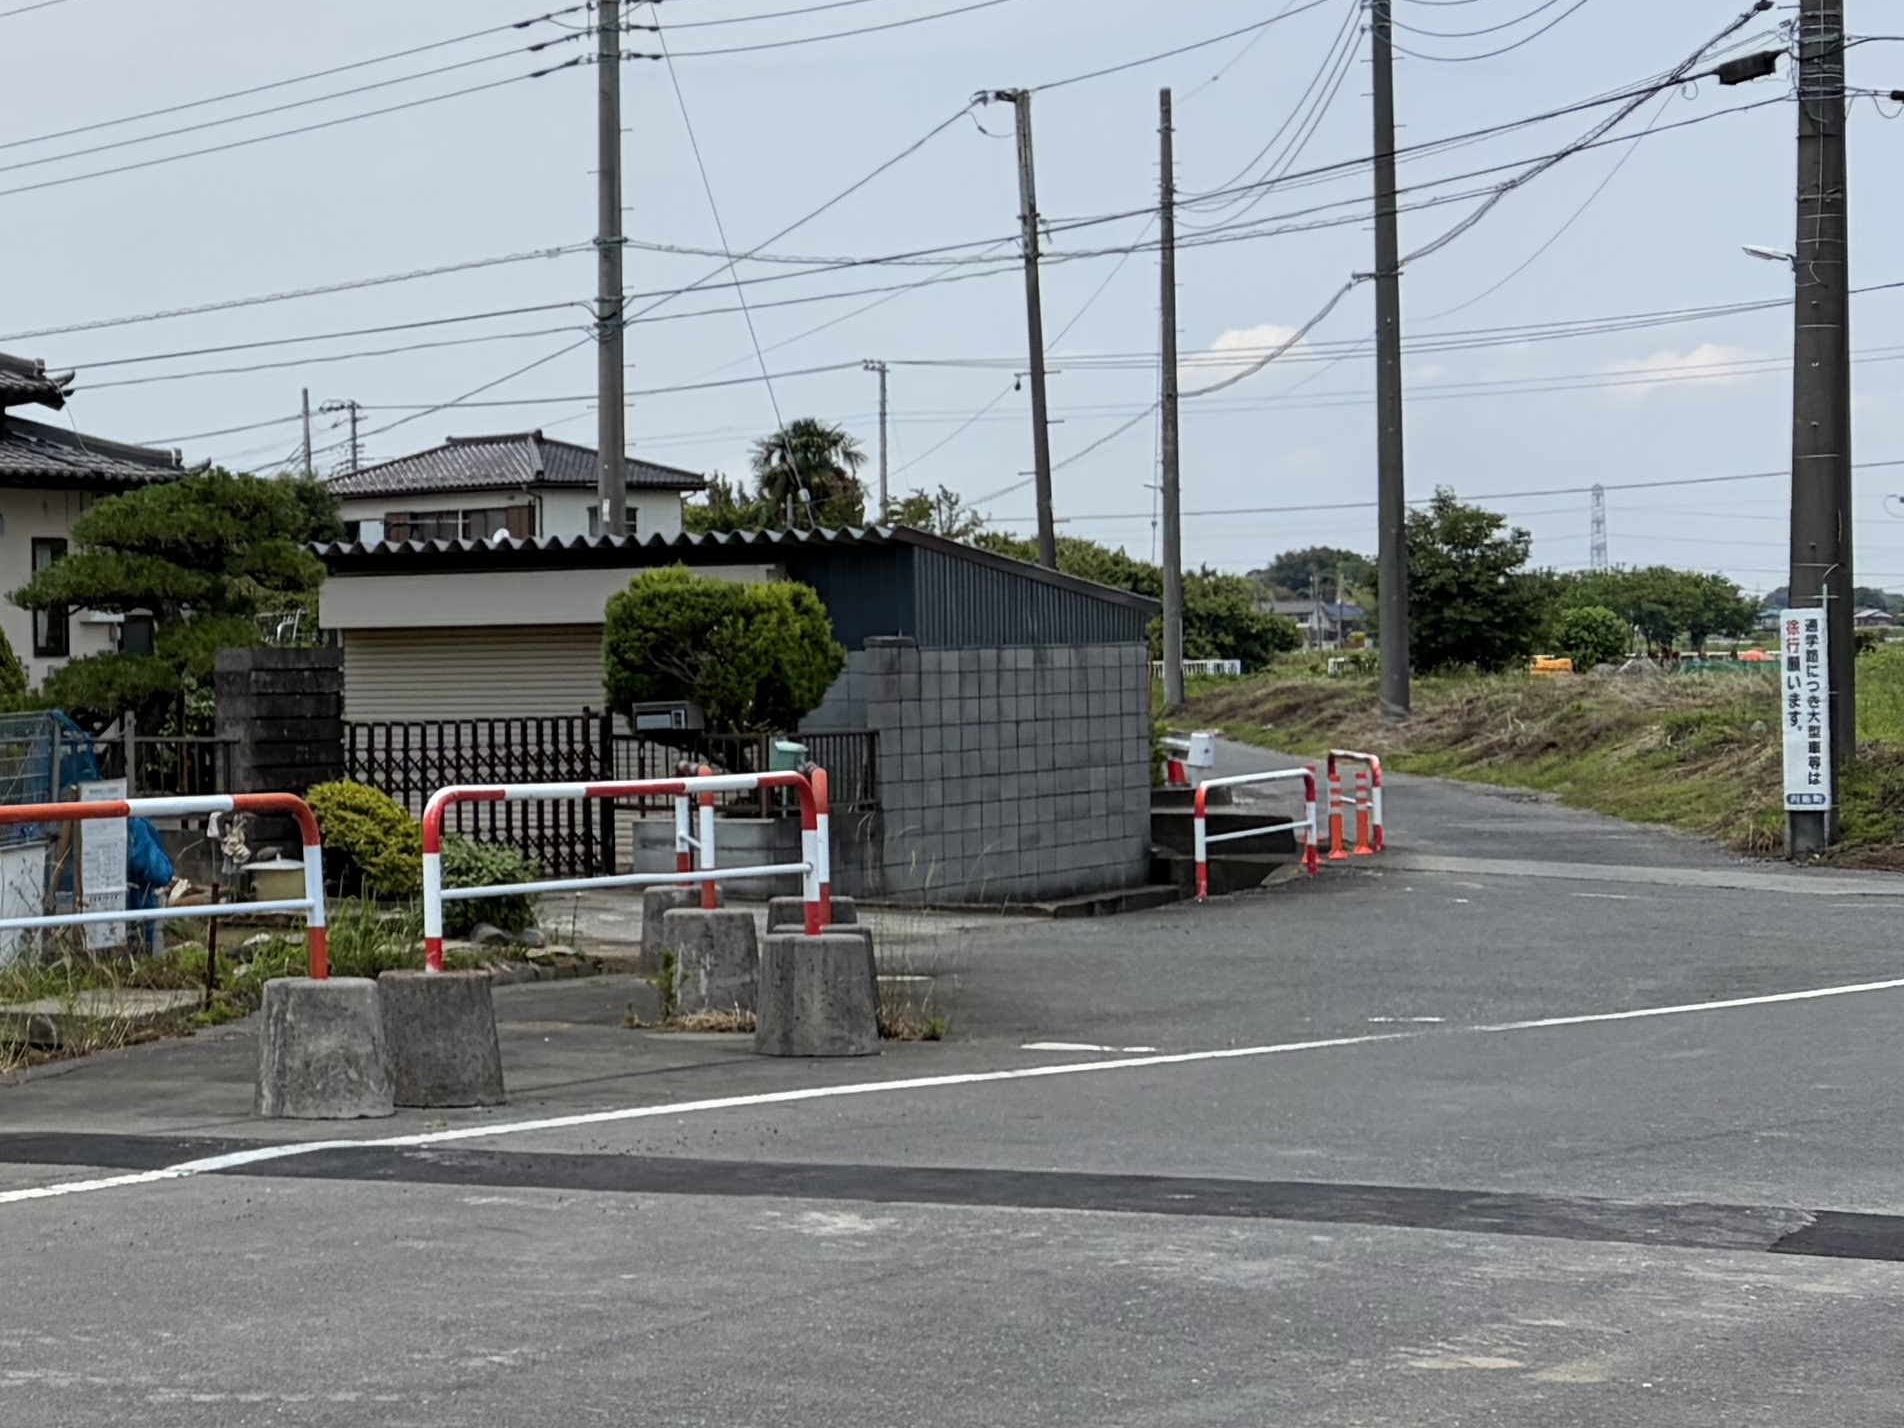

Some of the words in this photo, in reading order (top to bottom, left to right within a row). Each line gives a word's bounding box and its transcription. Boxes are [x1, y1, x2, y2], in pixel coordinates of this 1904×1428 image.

[1805, 619, 1821, 785] 通学路につき大型車等は
